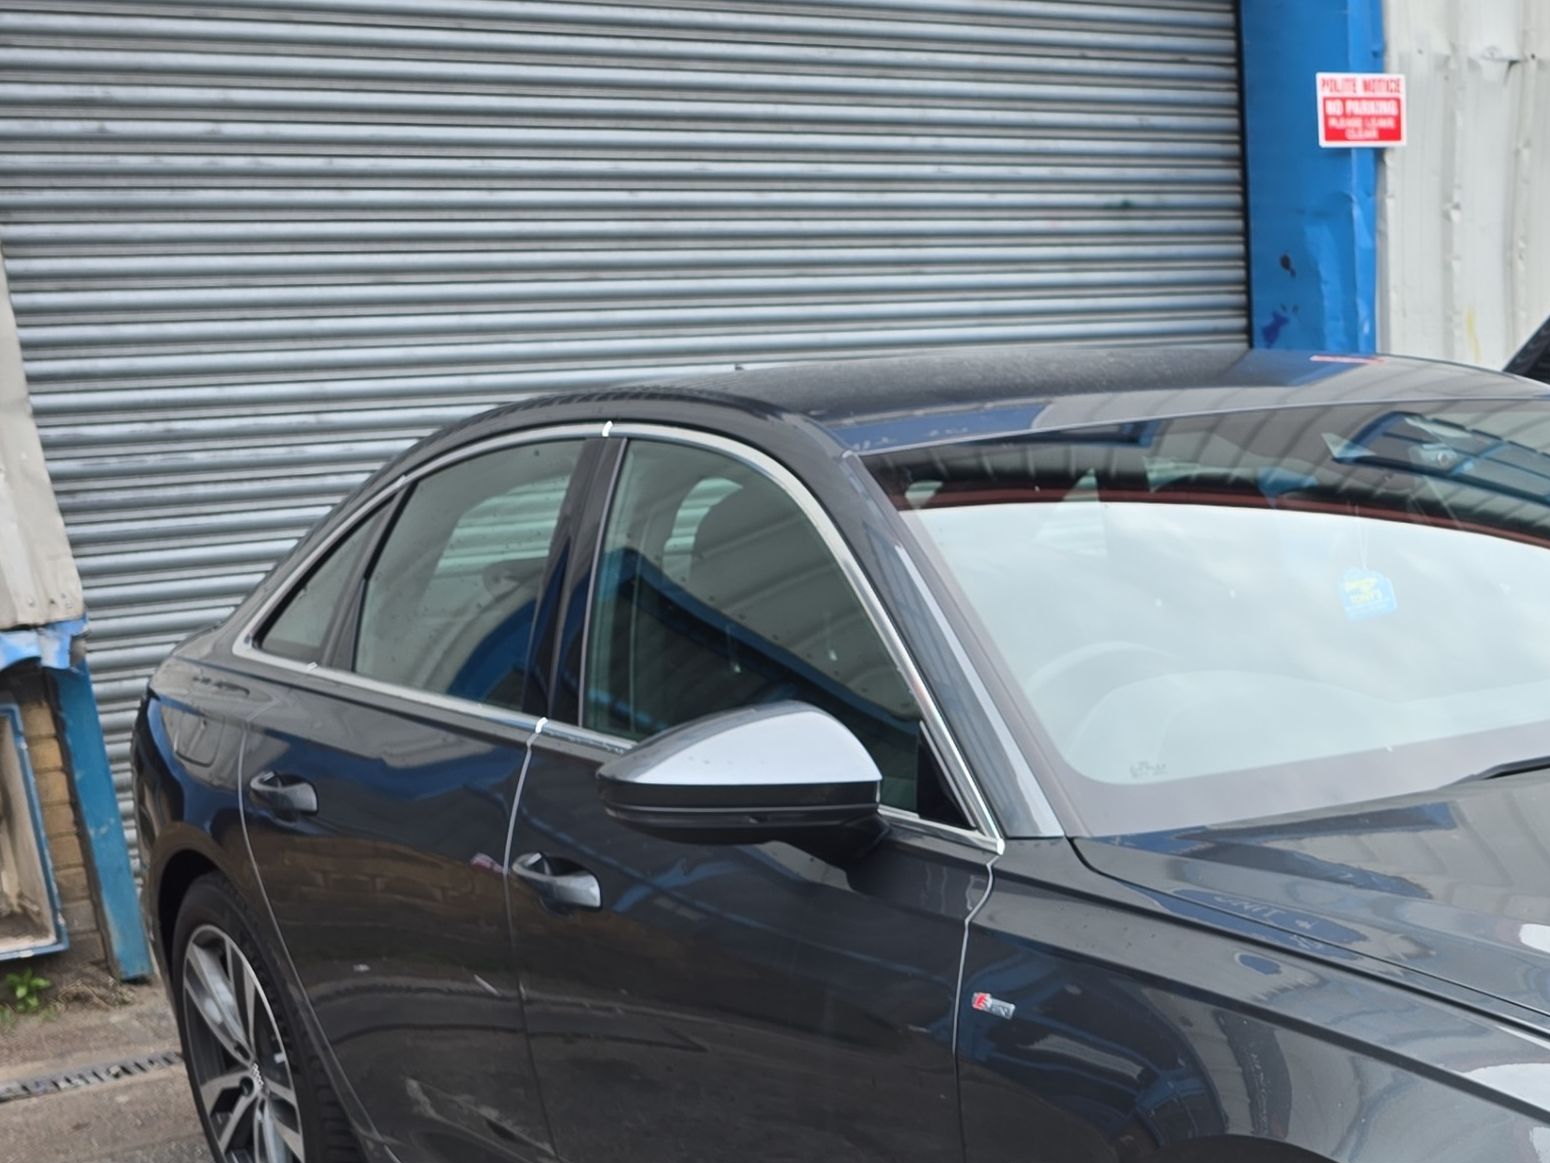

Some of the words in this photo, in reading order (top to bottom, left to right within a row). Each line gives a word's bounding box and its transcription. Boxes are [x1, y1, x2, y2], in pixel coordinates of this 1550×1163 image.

[1321, 78, 1357, 94] POLITE
[1363, 78, 1401, 94] NOTICE
[1325, 99, 1344, 116] NO
[1345, 99, 1399, 116] PARKING
